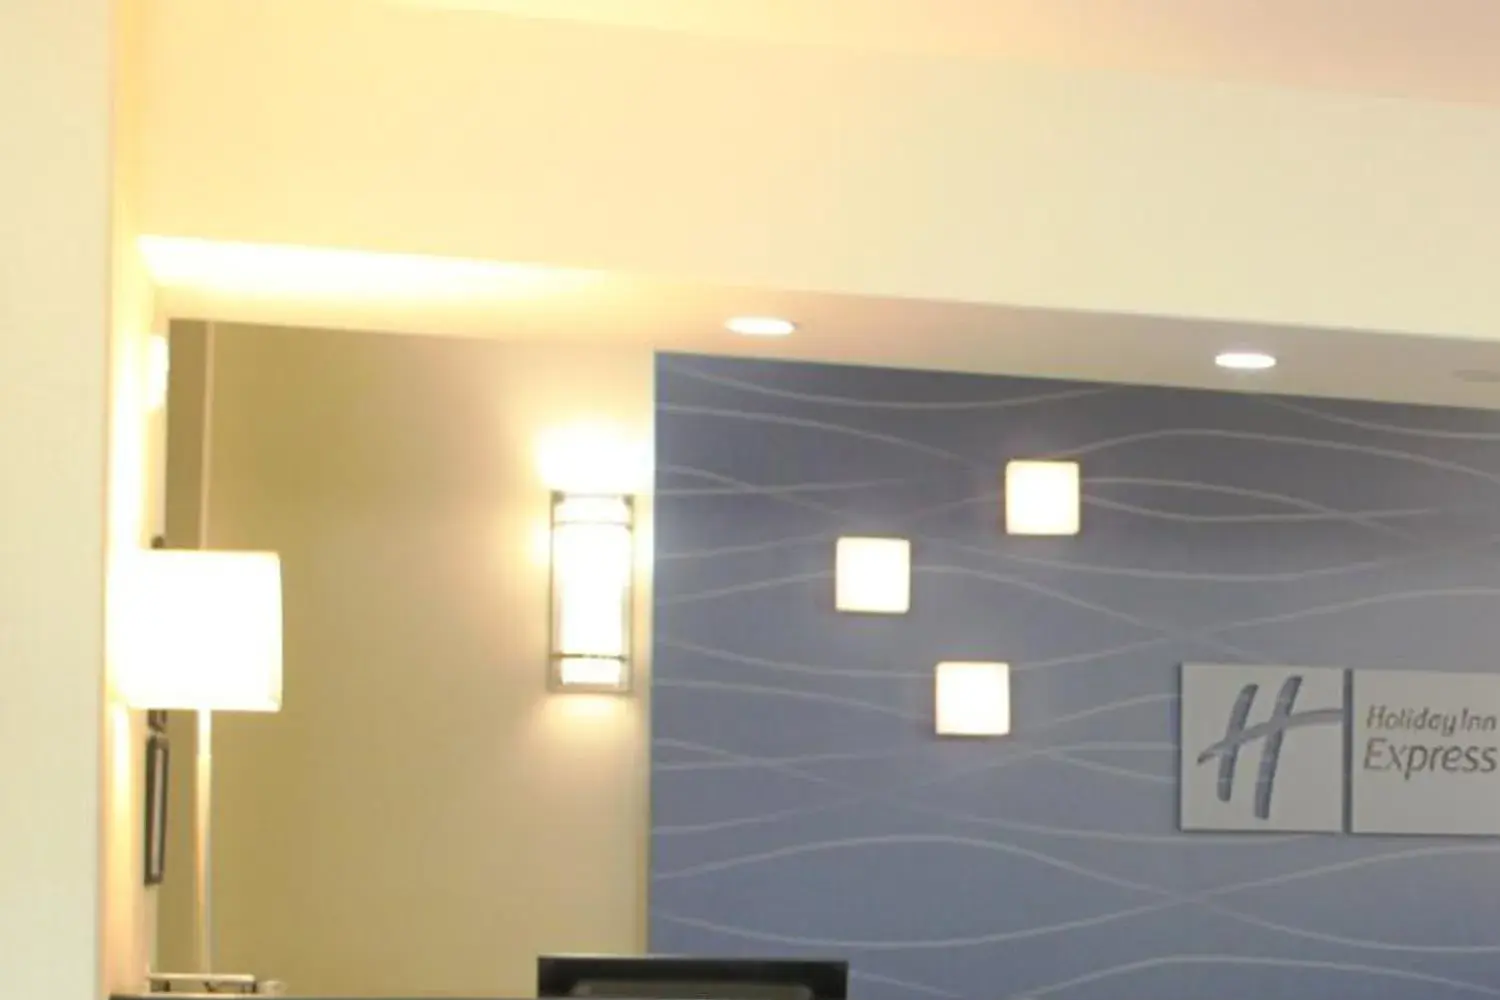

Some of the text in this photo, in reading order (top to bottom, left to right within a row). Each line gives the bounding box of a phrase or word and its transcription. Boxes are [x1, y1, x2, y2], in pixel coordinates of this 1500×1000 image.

[1366, 705, 1497, 736] Holiday Inn
[1363, 737, 1498, 780] Express
